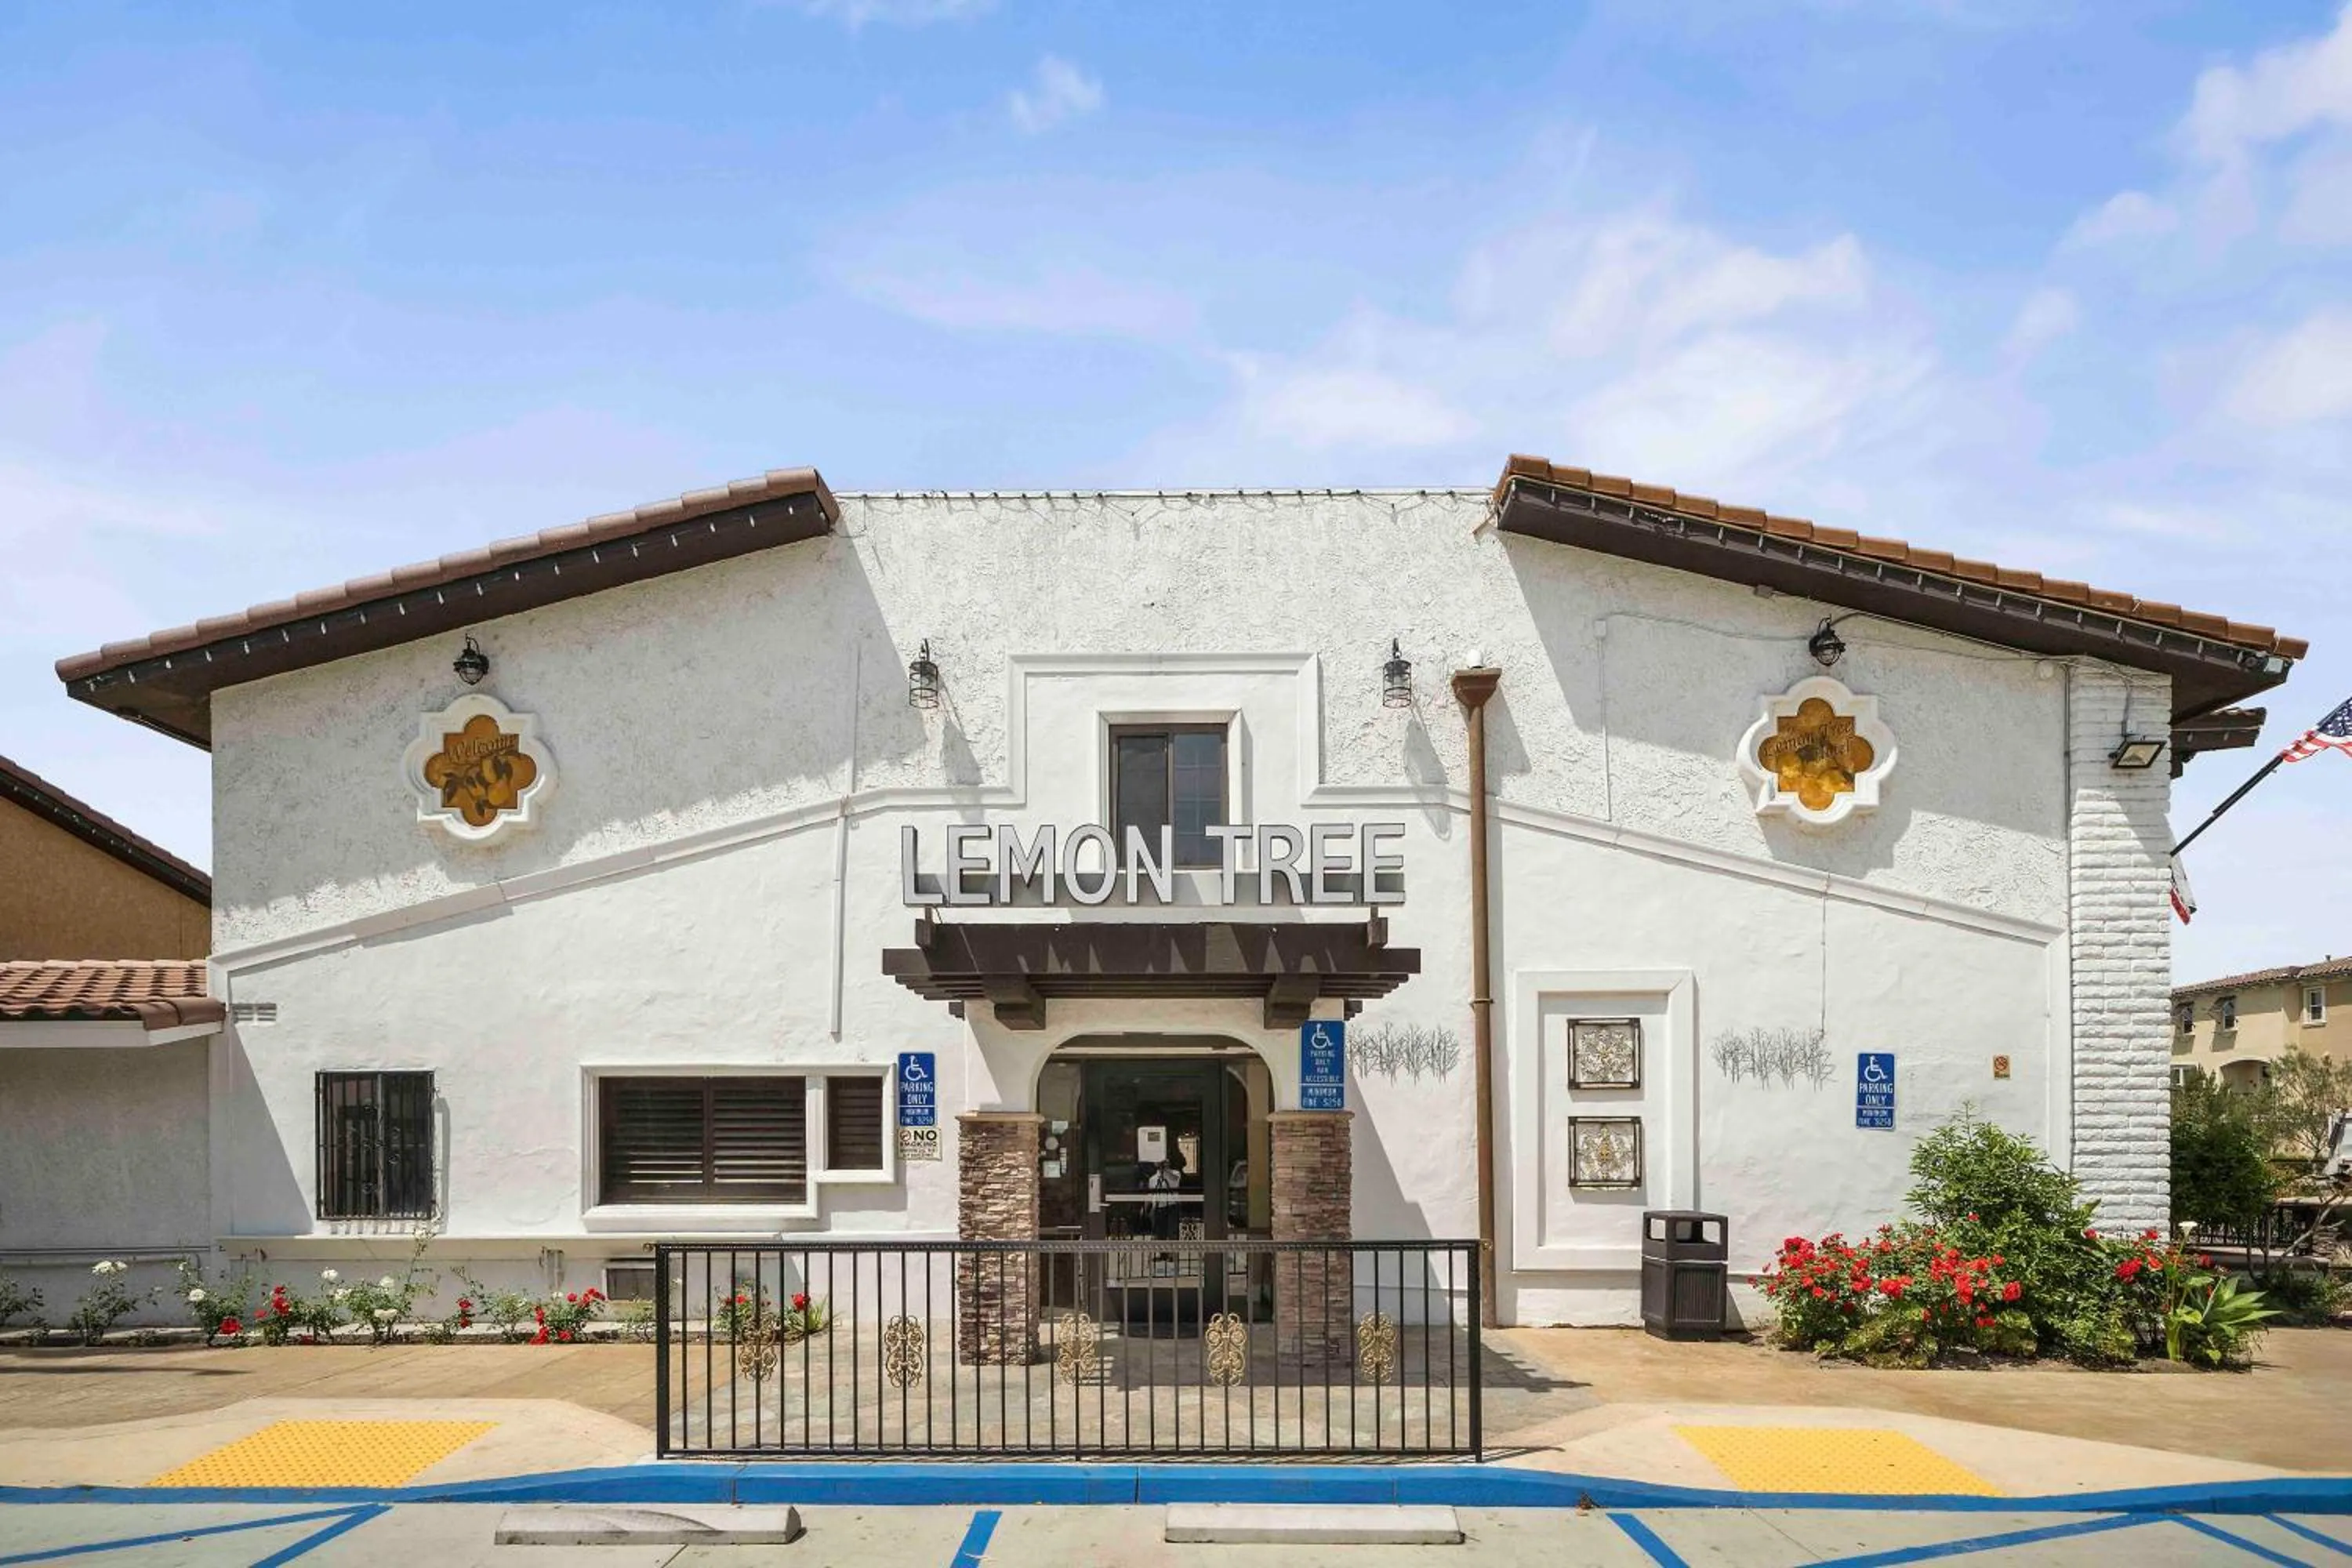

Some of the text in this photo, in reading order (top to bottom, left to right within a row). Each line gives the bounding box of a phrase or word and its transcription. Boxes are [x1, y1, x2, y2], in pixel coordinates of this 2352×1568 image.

[901, 823, 1406, 905] LEMON TREE
[900, 1082, 934, 1092] PARKING
[1859, 1083, 1893, 1094] PARKING
[907, 1094, 927, 1105] ONLY
[1865, 1094, 1887, 1105] ONLY
[913, 1130, 937, 1141] NO
